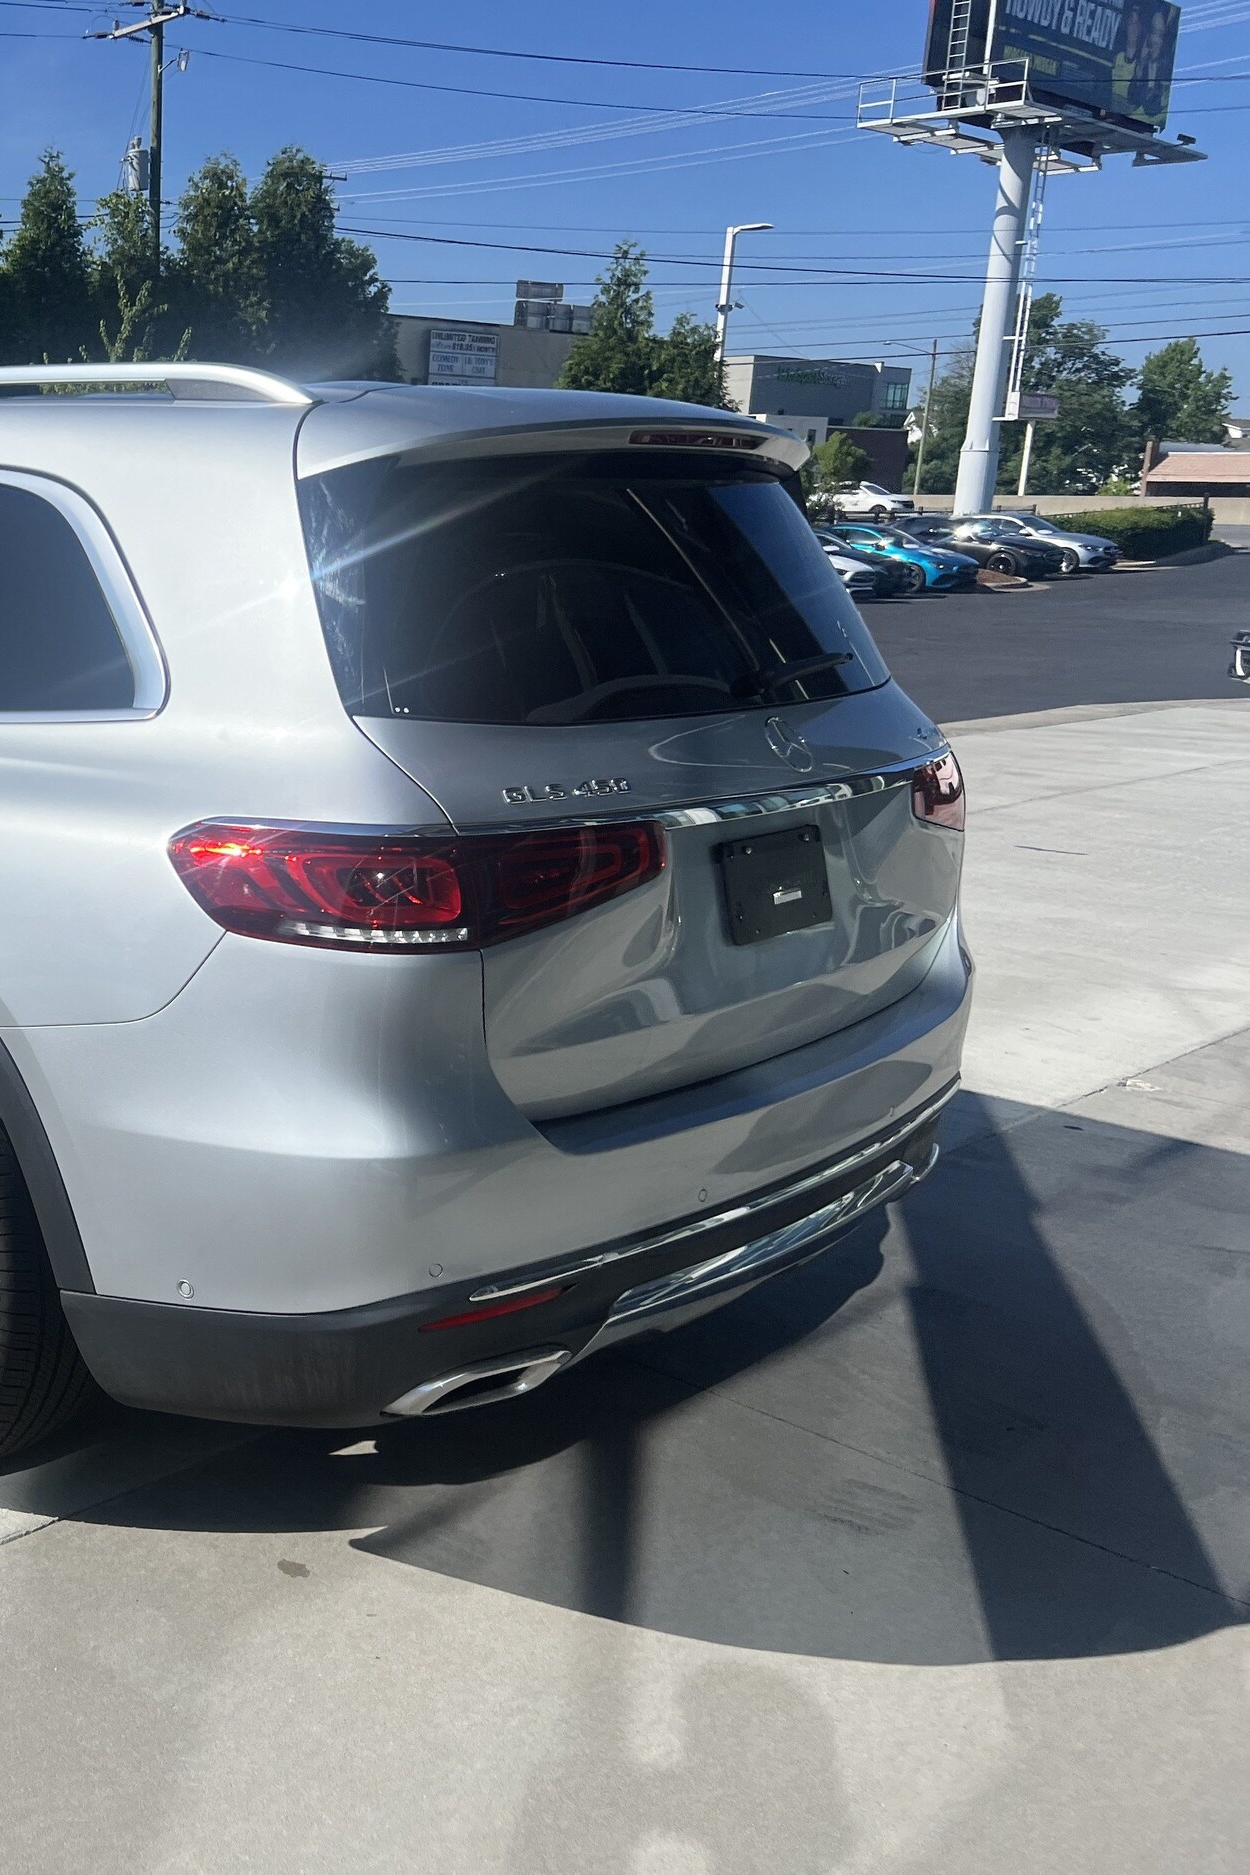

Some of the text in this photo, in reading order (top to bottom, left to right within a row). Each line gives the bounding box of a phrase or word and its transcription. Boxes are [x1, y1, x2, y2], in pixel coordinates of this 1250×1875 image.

[1072, 0, 1123, 51] READY
[502, 777, 632, 806] GLS 450
